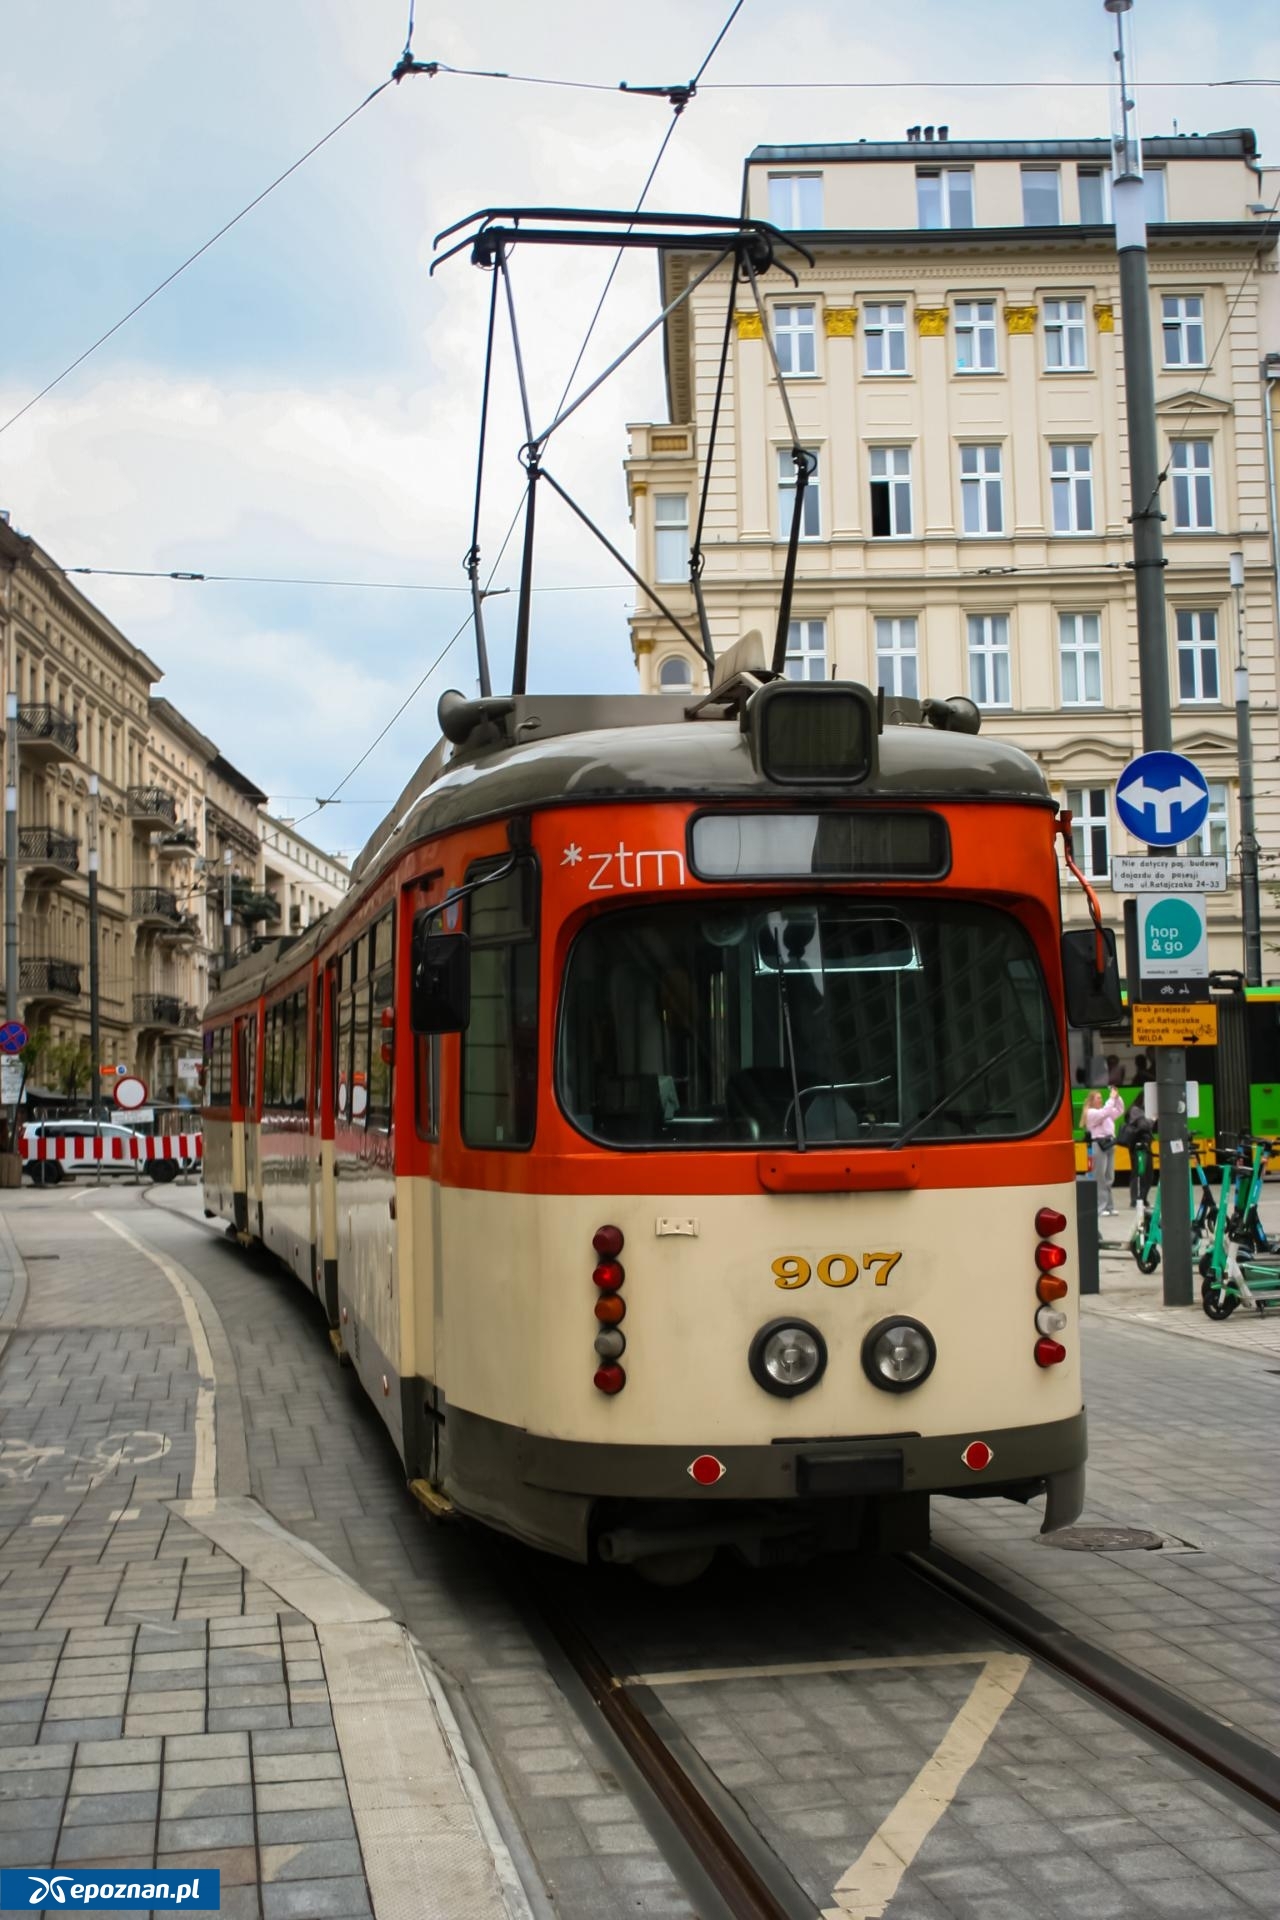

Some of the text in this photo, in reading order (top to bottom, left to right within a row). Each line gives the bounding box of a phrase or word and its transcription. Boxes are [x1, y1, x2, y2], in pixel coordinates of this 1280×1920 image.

[587, 841, 685, 890] ztm
[1140, 860, 1168, 869] dotyczy
[1190, 860, 1219, 868] budowy
[1120, 872, 1151, 880] dojazdu
[1171, 872, 1198, 880] posesji
[1150, 924, 1179, 940] hop
[1151, 938, 1183, 954] & go
[1134, 1005, 1151, 1013] Brak
[771, 1251, 902, 1290] 907
